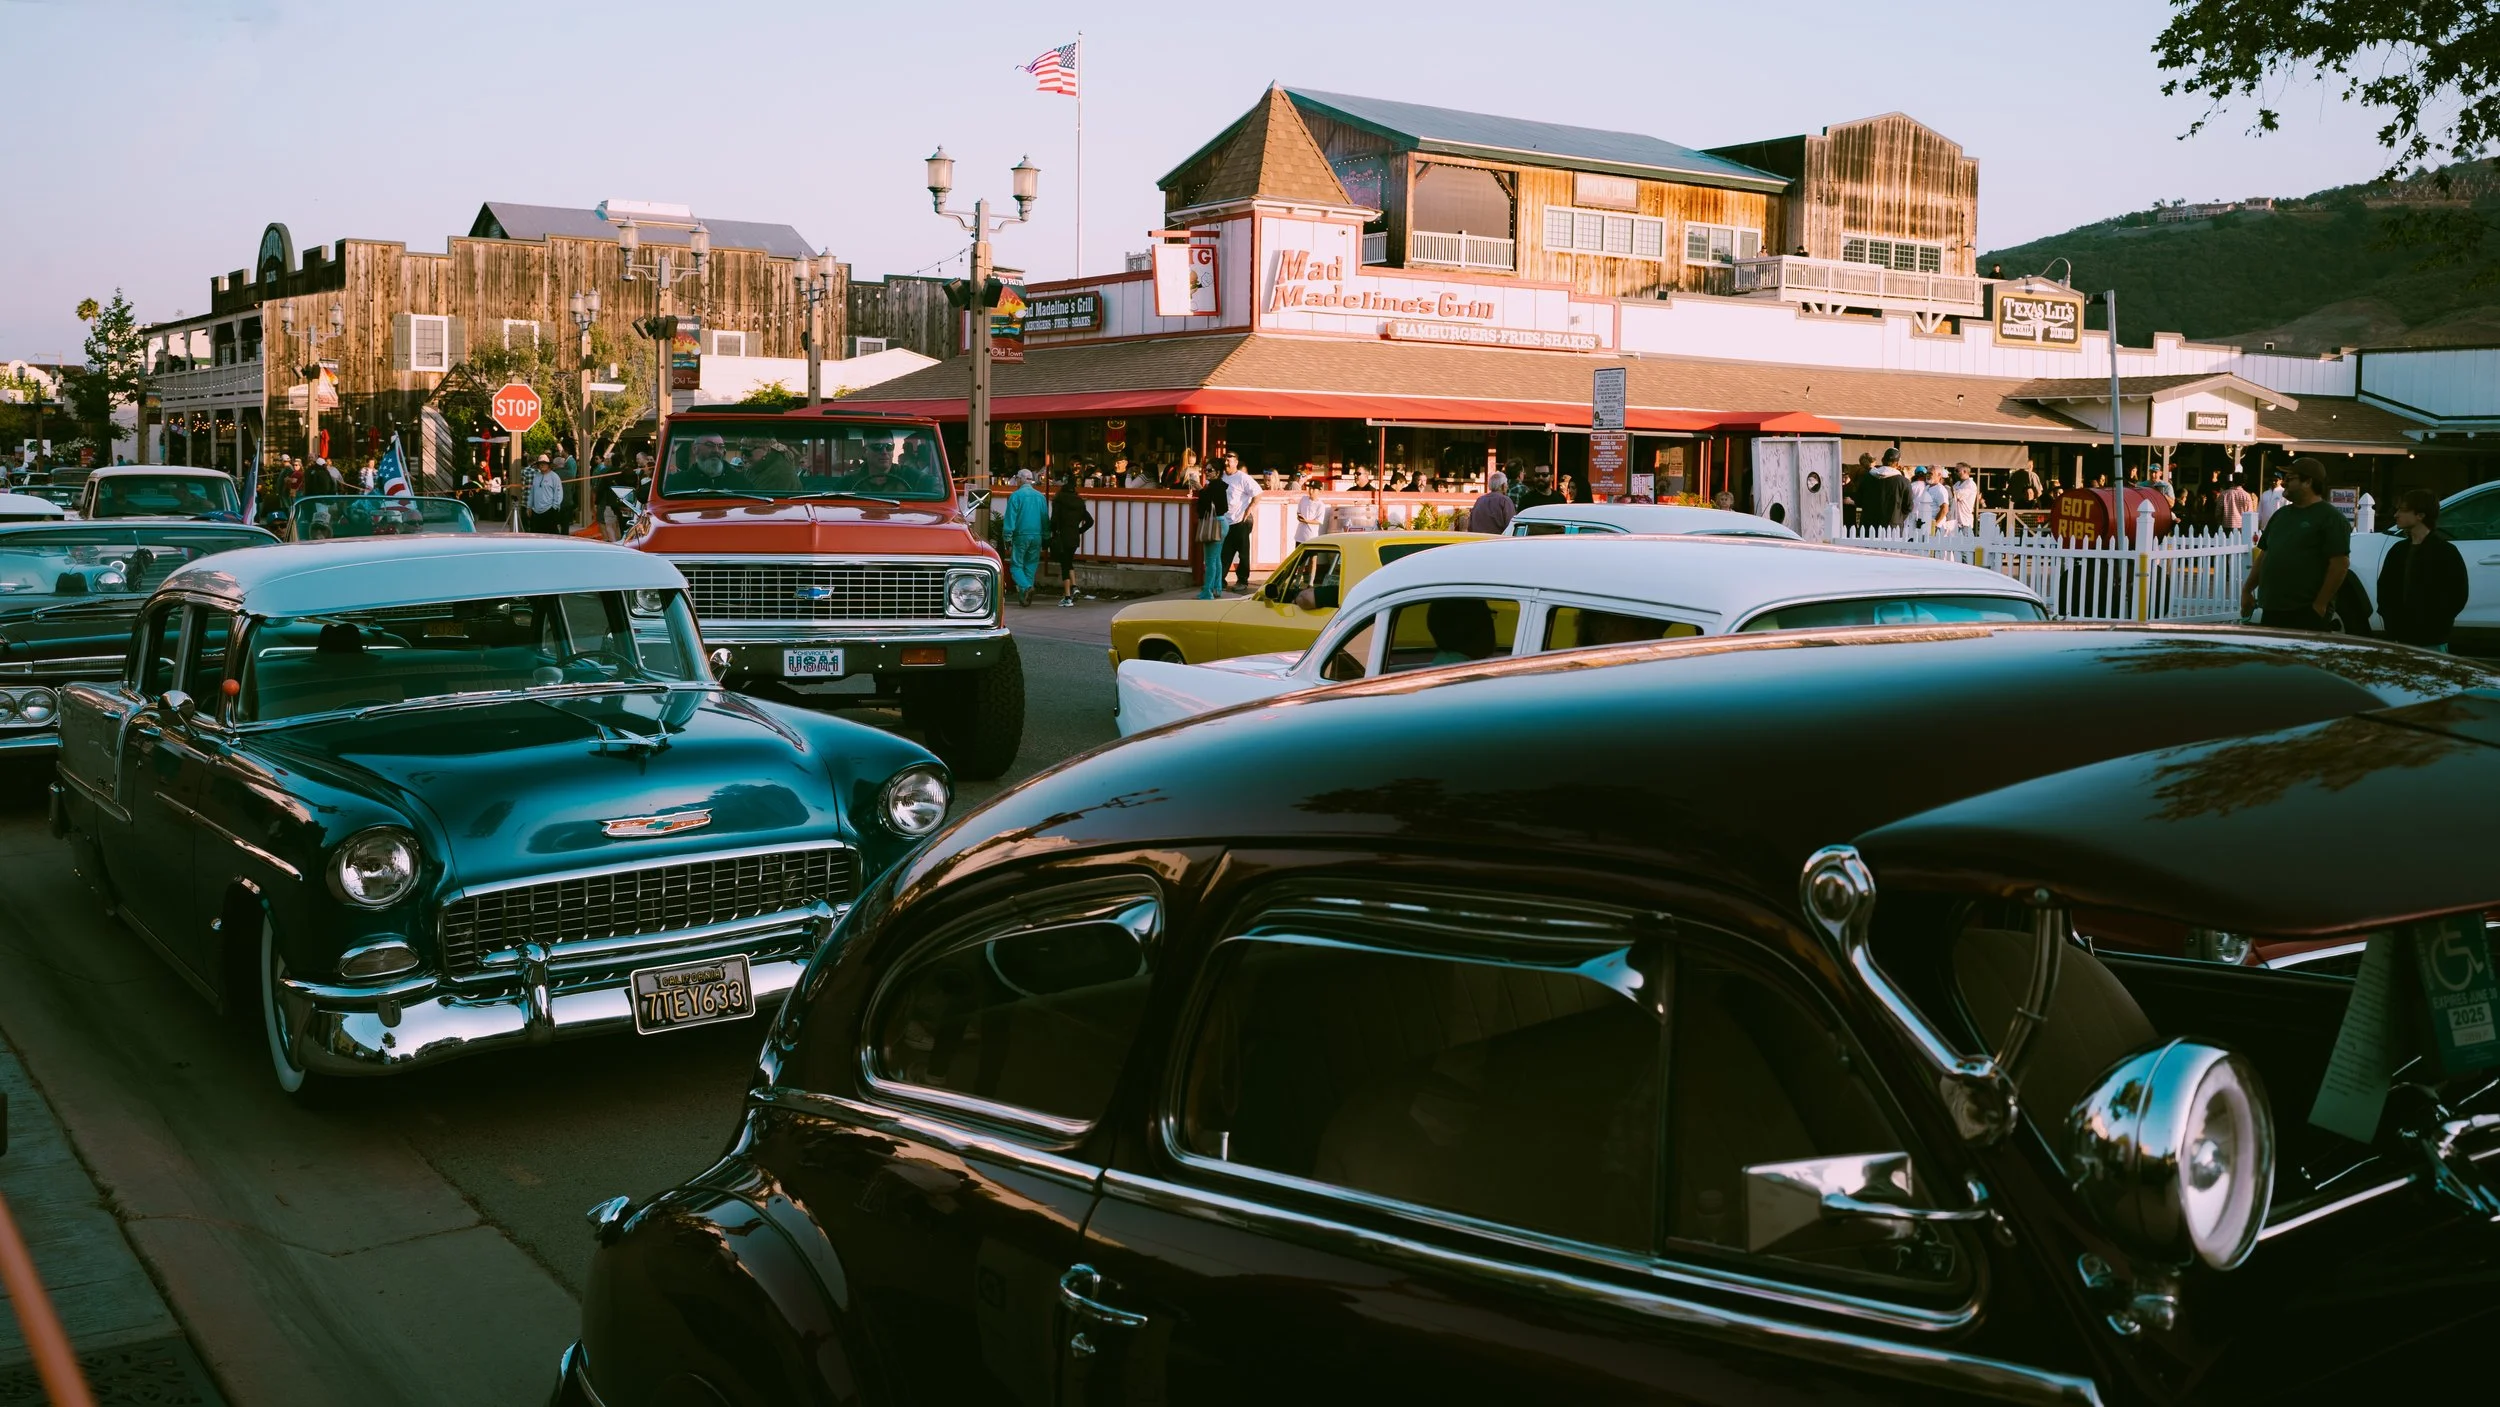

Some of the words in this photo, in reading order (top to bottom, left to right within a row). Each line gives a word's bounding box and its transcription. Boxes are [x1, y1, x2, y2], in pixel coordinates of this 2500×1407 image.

[1276, 250, 1343, 285] Mad
[1008, 278, 1025, 287] RUN
[1025, 302, 1034, 318] ad
[1035, 299, 1075, 317] Madeline's
[1077, 296, 1093, 313] Grill
[1269, 285, 1435, 314] Madeline's
[1438, 292, 1494, 319] Grill
[1054, 318, 1069, 329] FRIES
[1072, 316, 1091, 327] SHAKES
[991, 347, 1006, 357] Old
[1008, 347, 1023, 357] Town
[674, 376, 686, 385] Old
[496, 399, 538, 417] STOP
[2197, 416, 2227, 426] ENTRANCE
[272, 511, 279, 519] T
[2061, 497, 2094, 519] GOT
[662, 969, 722, 986] CALIFORNIA
[645, 981, 743, 1020] 7TEY633
[2432, 992, 2469, 1010] EXPIRES
[2469, 988, 2488, 1004] JUNE
[2452, 1007, 2486, 1027] 2025
